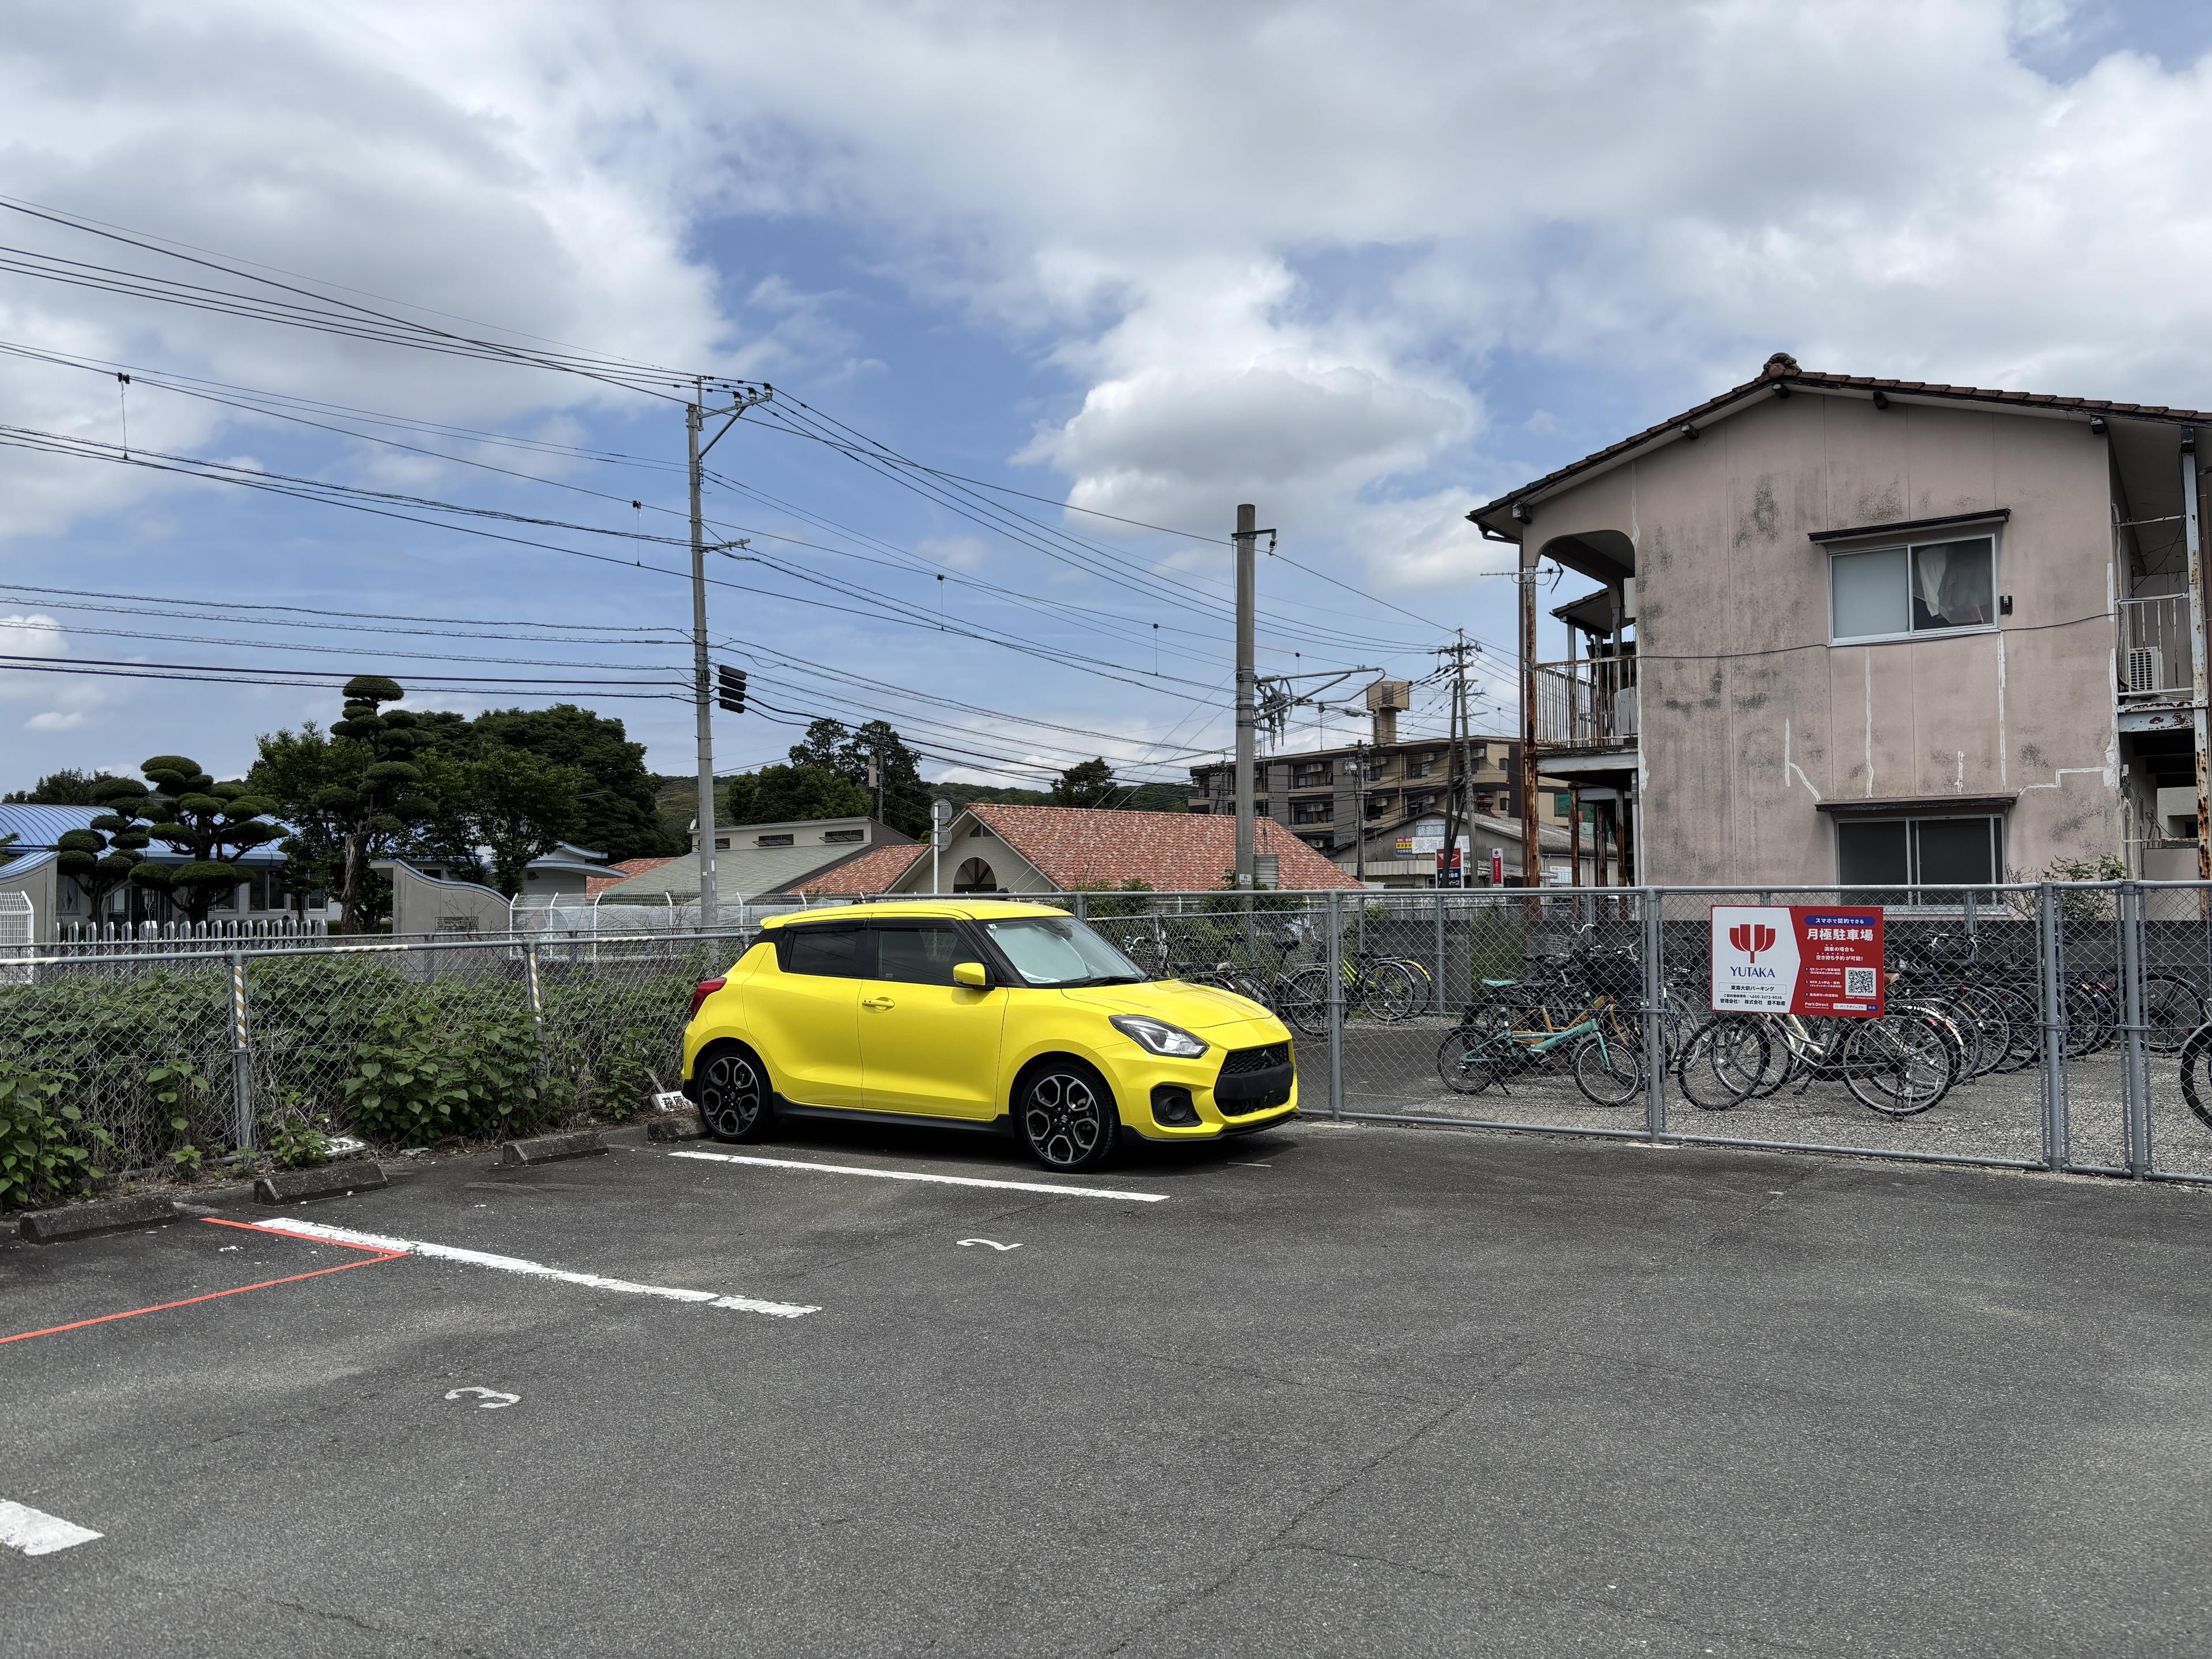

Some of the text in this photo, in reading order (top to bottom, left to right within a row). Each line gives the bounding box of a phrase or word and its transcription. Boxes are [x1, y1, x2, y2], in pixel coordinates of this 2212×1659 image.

[1807, 928, 1873, 941] 月極駐車場
[1730, 966, 1775, 978] YUTAKA
[445, 1387, 521, 1408] 3
